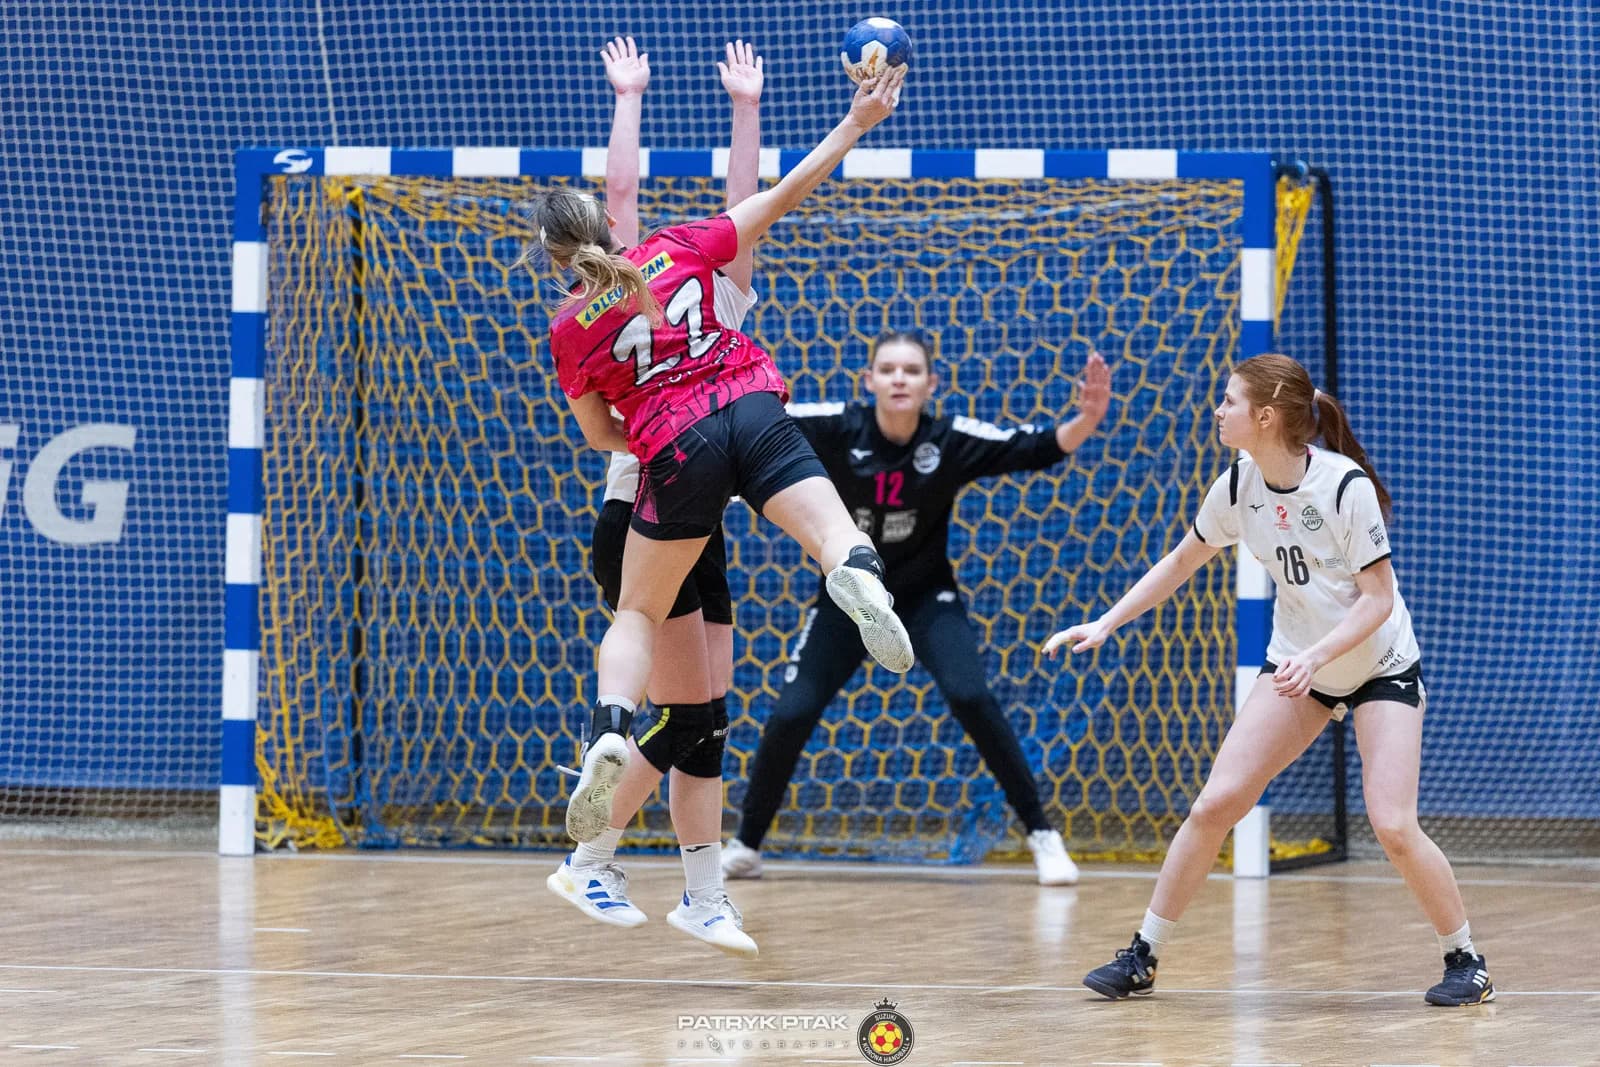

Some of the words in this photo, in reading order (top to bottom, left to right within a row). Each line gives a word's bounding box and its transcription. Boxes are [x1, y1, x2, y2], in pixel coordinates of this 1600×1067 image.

[612, 276, 722, 386] 22
[874, 471, 904, 507] 12
[1276, 545, 1310, 586] 26
